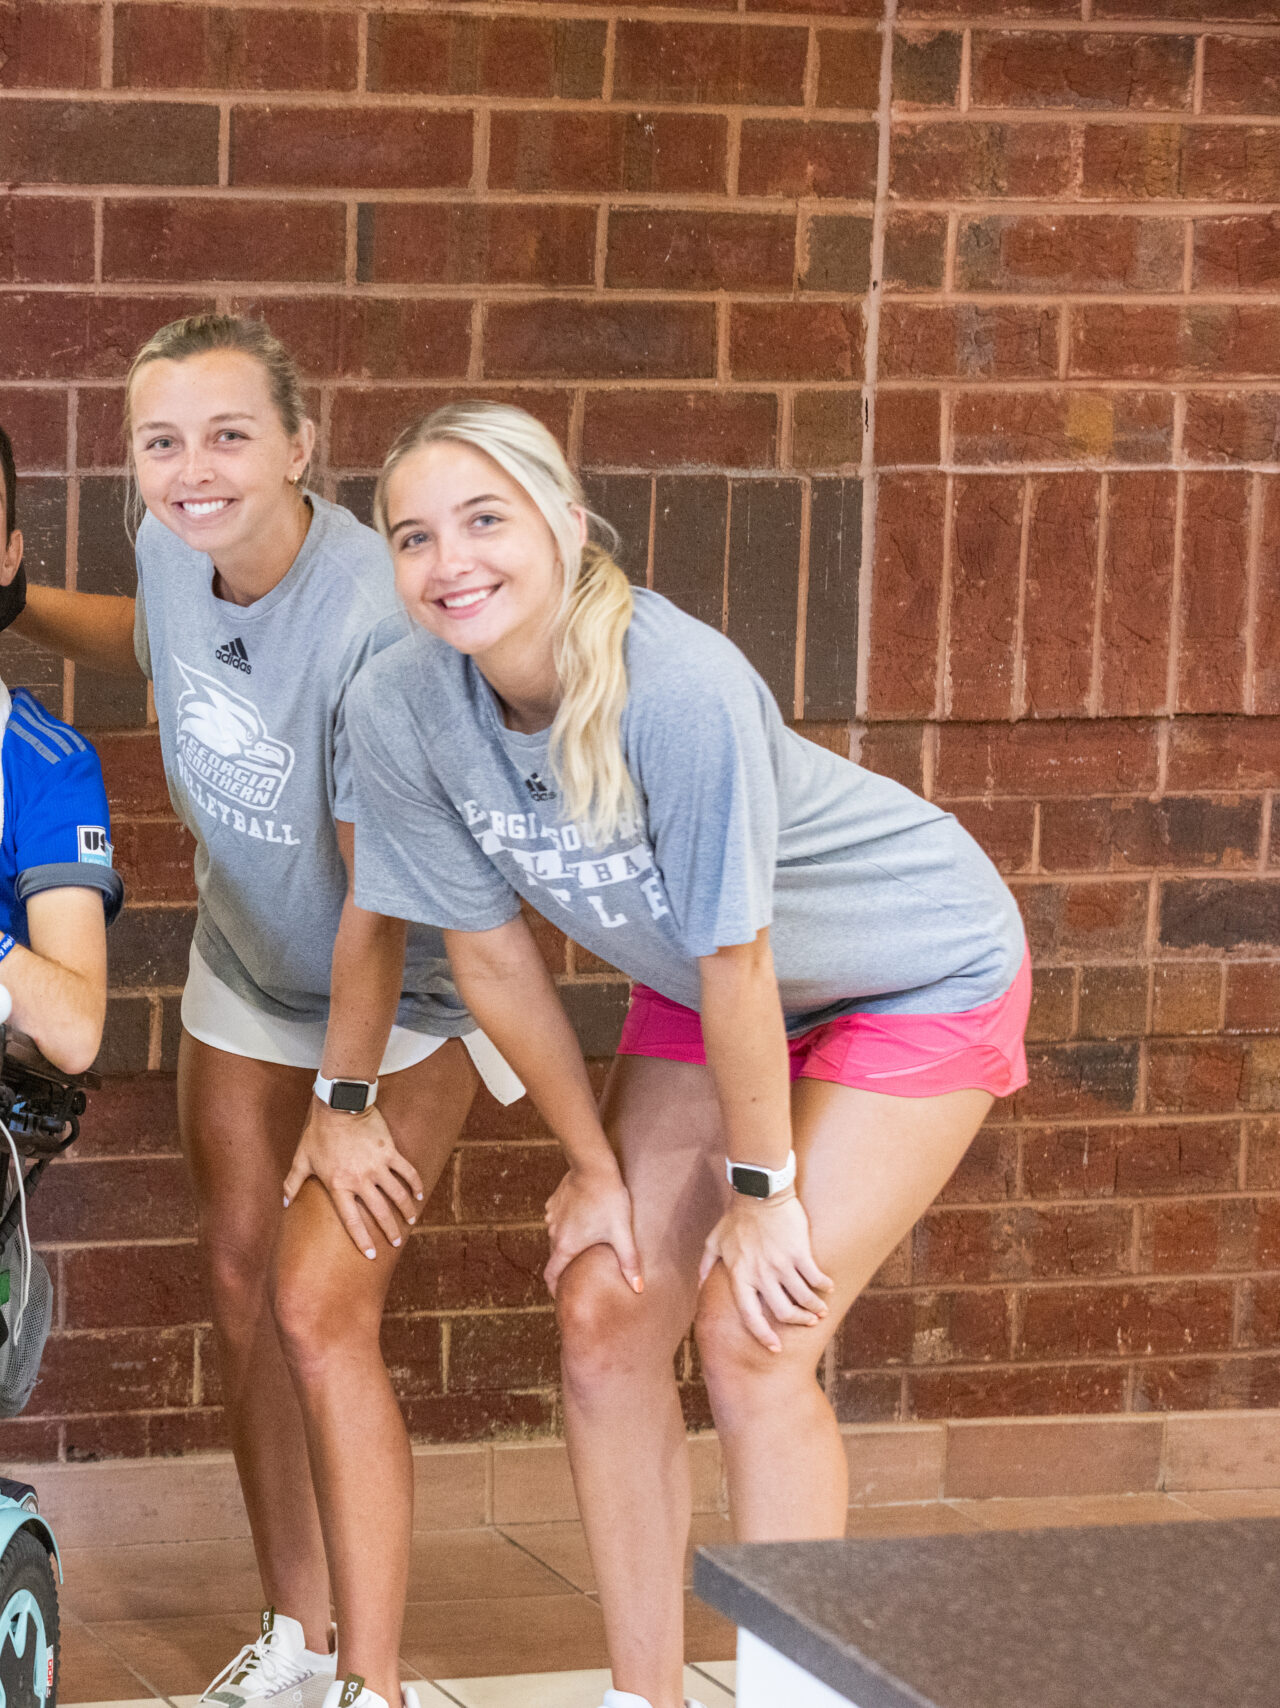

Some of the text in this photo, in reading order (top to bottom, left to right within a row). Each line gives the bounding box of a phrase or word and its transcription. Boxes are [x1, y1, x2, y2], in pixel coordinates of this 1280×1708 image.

[215, 648, 252, 675] adidas
[184, 747, 271, 805] SOUTHERN
[188, 736, 278, 791] GEORGIA
